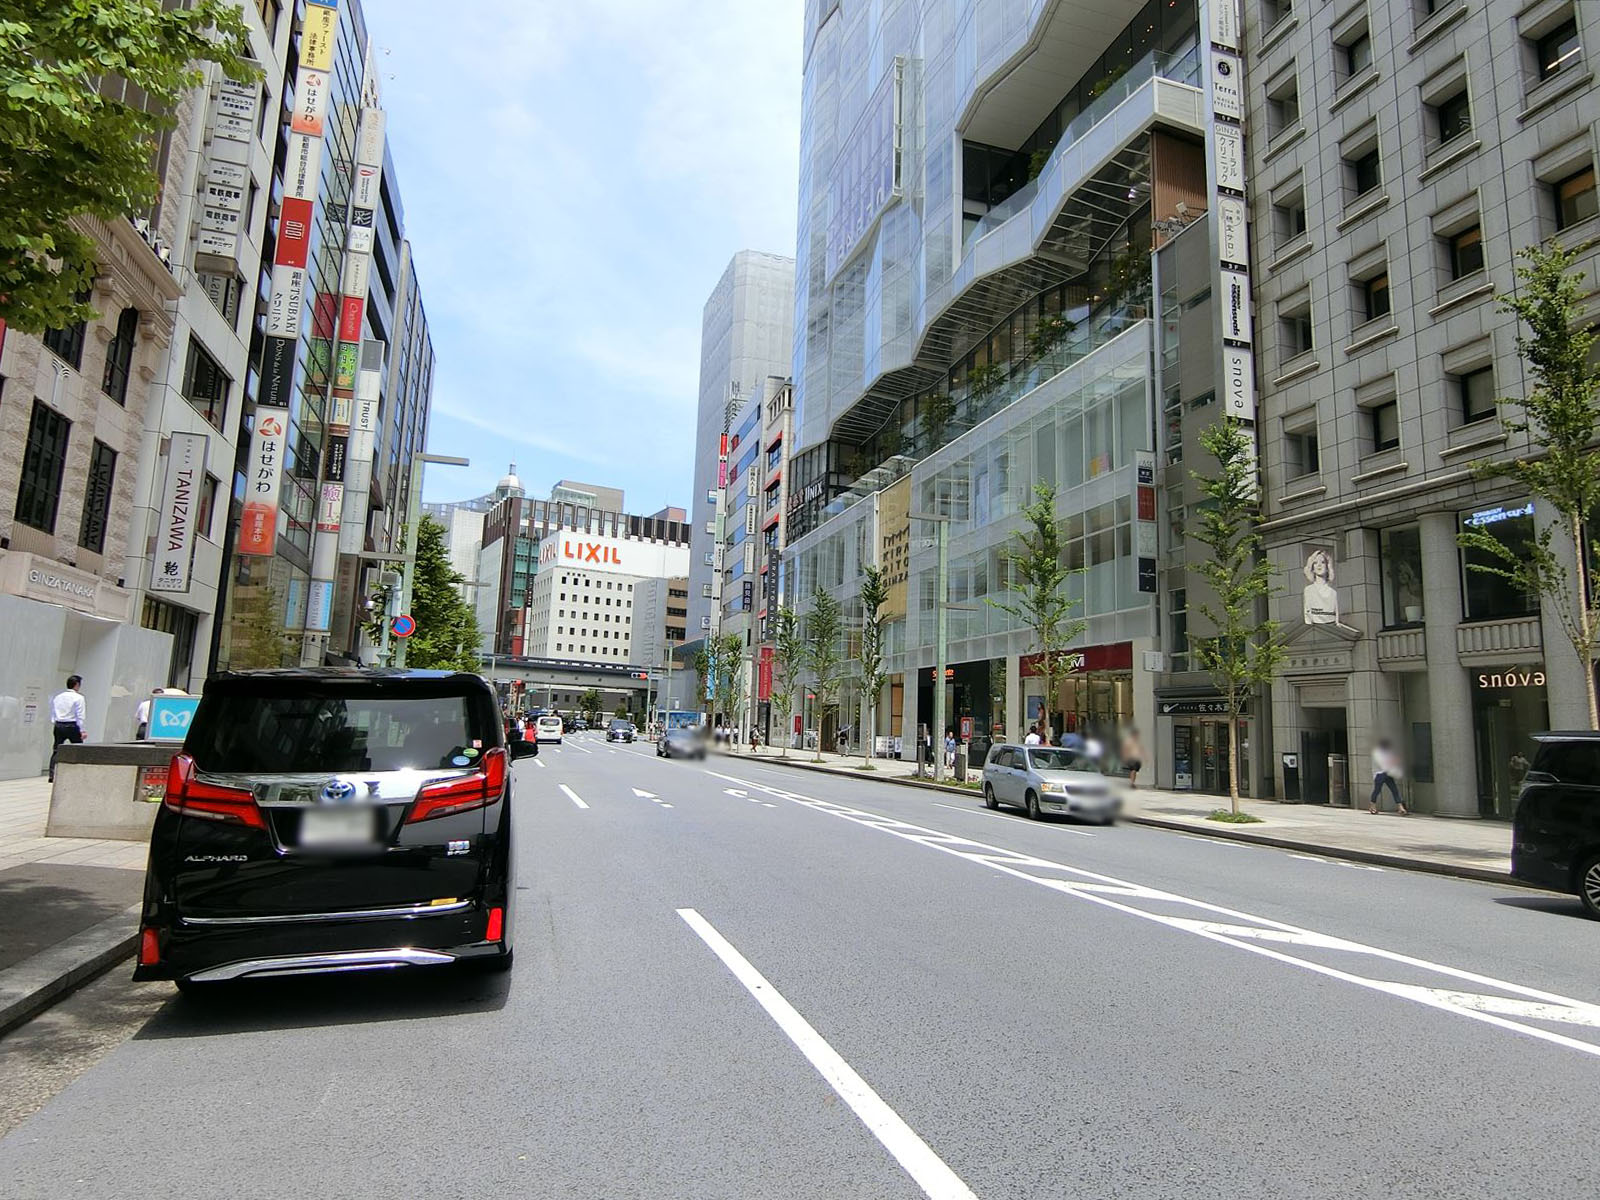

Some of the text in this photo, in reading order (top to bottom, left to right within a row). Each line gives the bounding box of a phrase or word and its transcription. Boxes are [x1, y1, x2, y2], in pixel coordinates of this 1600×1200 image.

[1213, 82, 1237, 96] Terra
[304, 88, 318, 122] はせがわ
[1216, 125, 1240, 137] GINZA
[1219, 137, 1229, 183] クリニック
[1228, 138, 1237, 177] オーラル
[209, 187, 240, 199] 電鉄商事
[205, 210, 237, 222] 電鉄商事
[270, 292, 283, 331] クリニック
[360, 401, 371, 430] TRUST
[255, 440, 276, 493] はせがわ
[168, 470, 193, 552] TANIZAWA
[565, 541, 621, 564] LIXIL
[164, 561, 179, 576] 鞄
